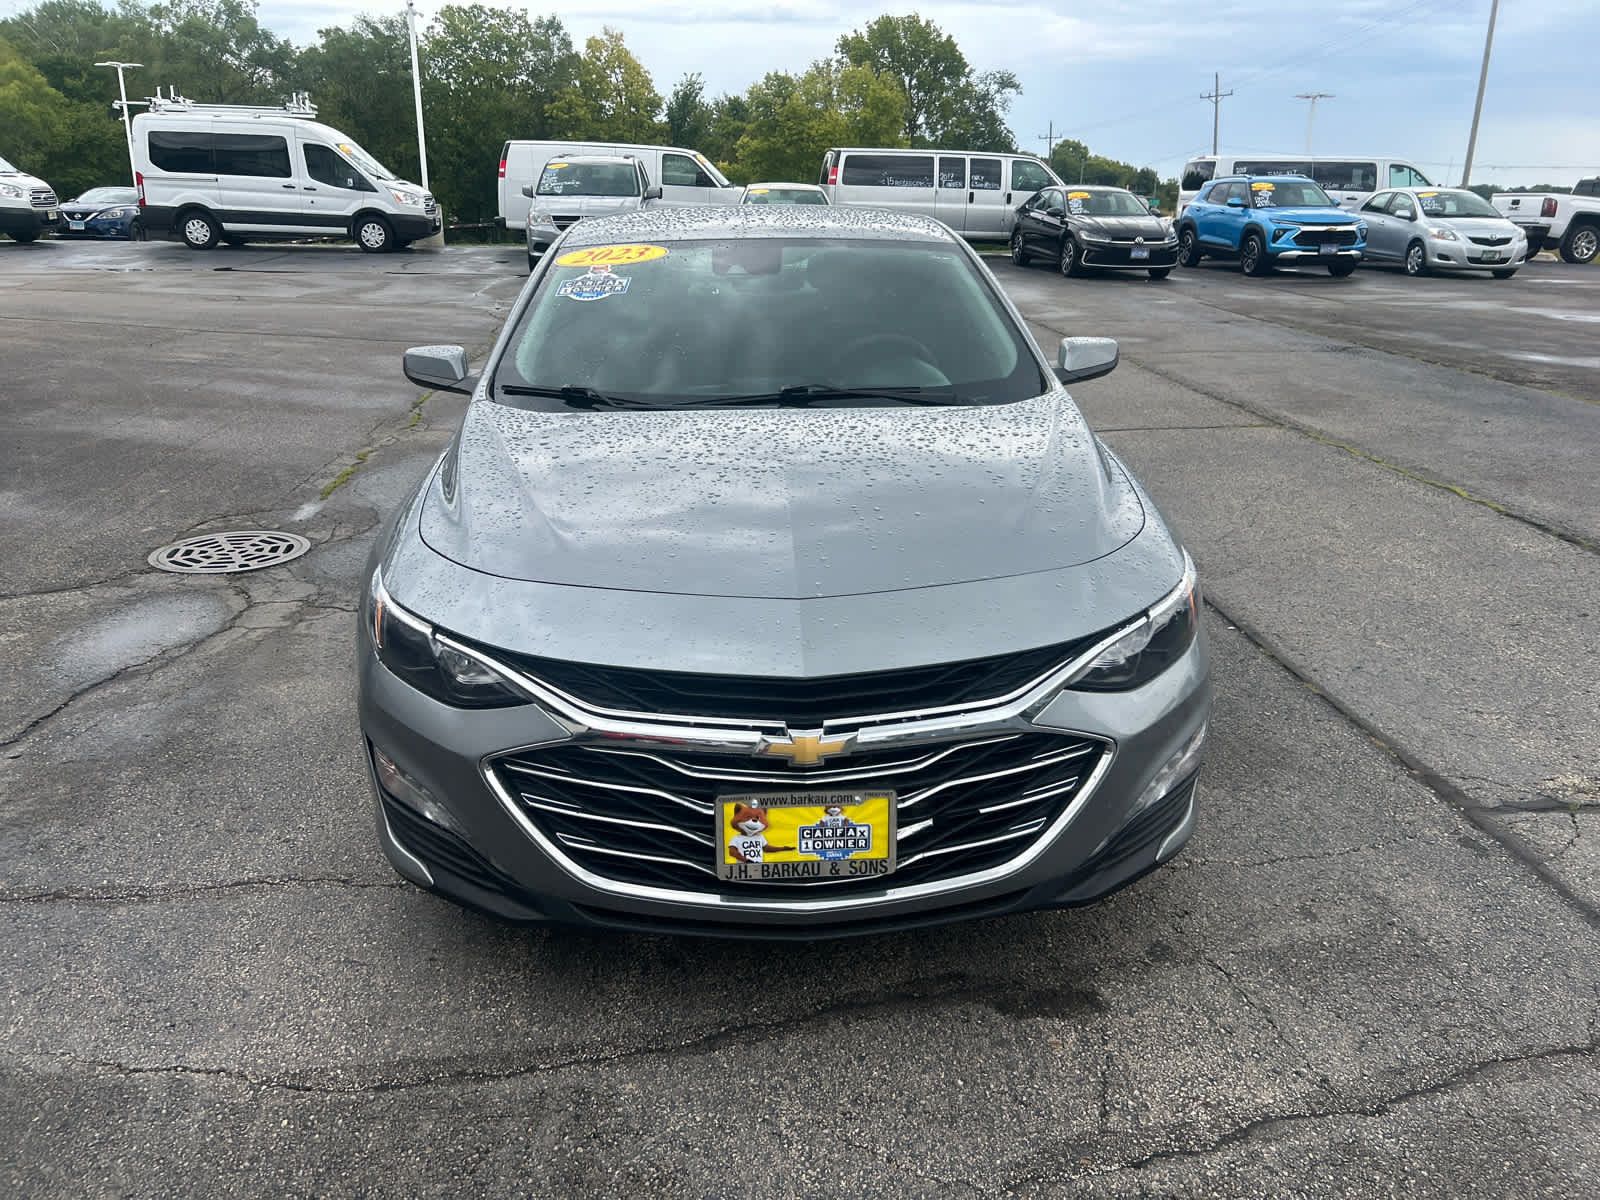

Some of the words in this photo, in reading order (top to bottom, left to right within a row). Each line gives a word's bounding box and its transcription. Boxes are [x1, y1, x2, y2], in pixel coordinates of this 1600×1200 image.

[573, 247, 650, 263] 2023
[760, 793, 853, 806] www.barkau.com
[803, 828, 867, 838] CARFAX
[742, 840, 761, 849] CAR
[804, 839, 811, 849] 1
[814, 838, 867, 849] OWNER
[743, 848, 761, 858] FOX
[725, 866, 753, 880] J.H.
[761, 861, 821, 878] BARKAU
[829, 862, 840, 875] &
[849, 859, 888, 875] SONS
